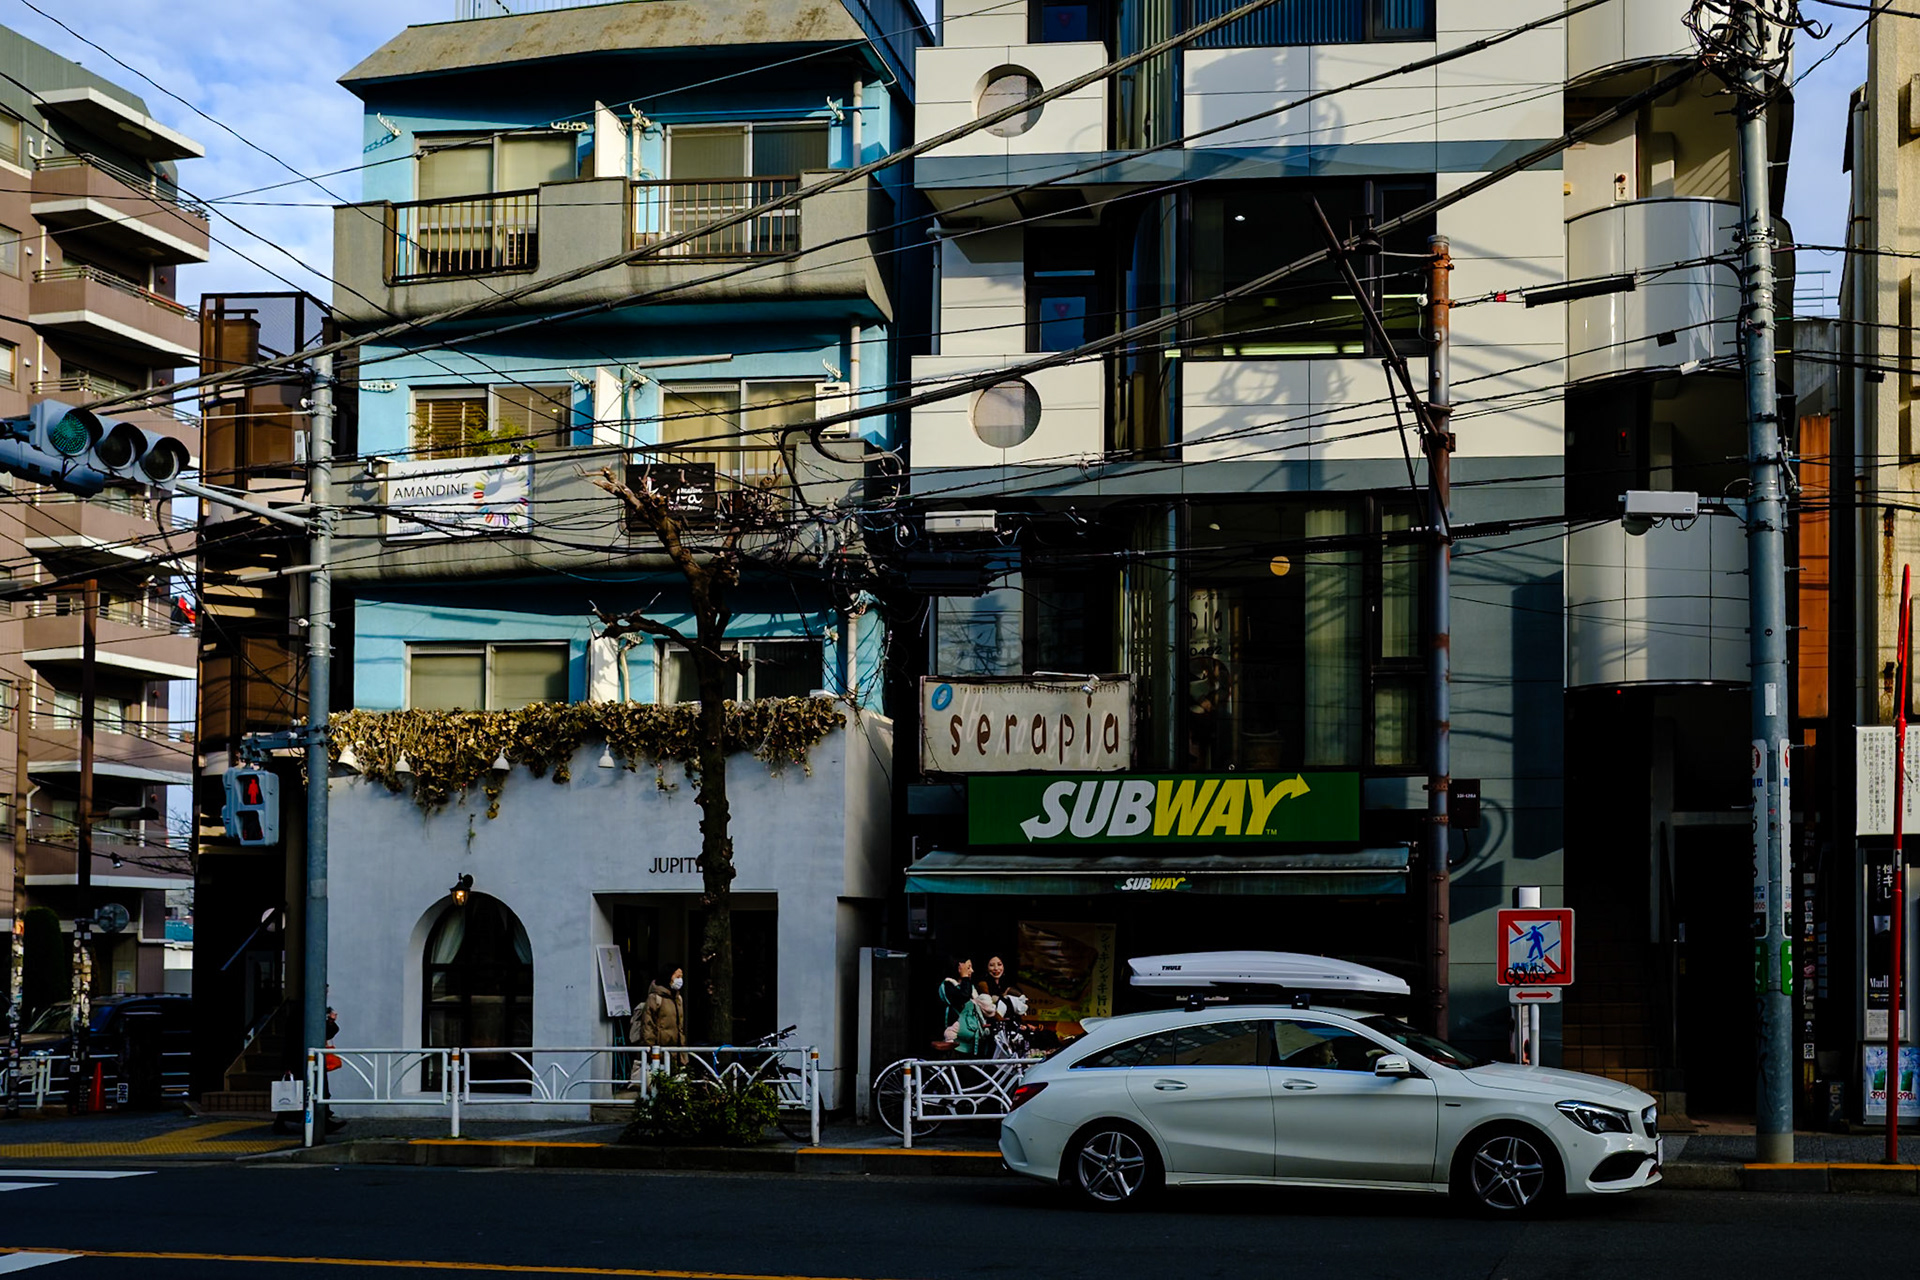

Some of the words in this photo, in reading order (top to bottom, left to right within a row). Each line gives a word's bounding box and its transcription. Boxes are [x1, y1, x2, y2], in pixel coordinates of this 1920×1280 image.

[393, 483, 469, 499] AMANDINE
[950, 695, 1120, 765] serapia
[1020, 774, 1310, 842] SUBWAY
[1119, 876, 1187, 891] SUBWAY
